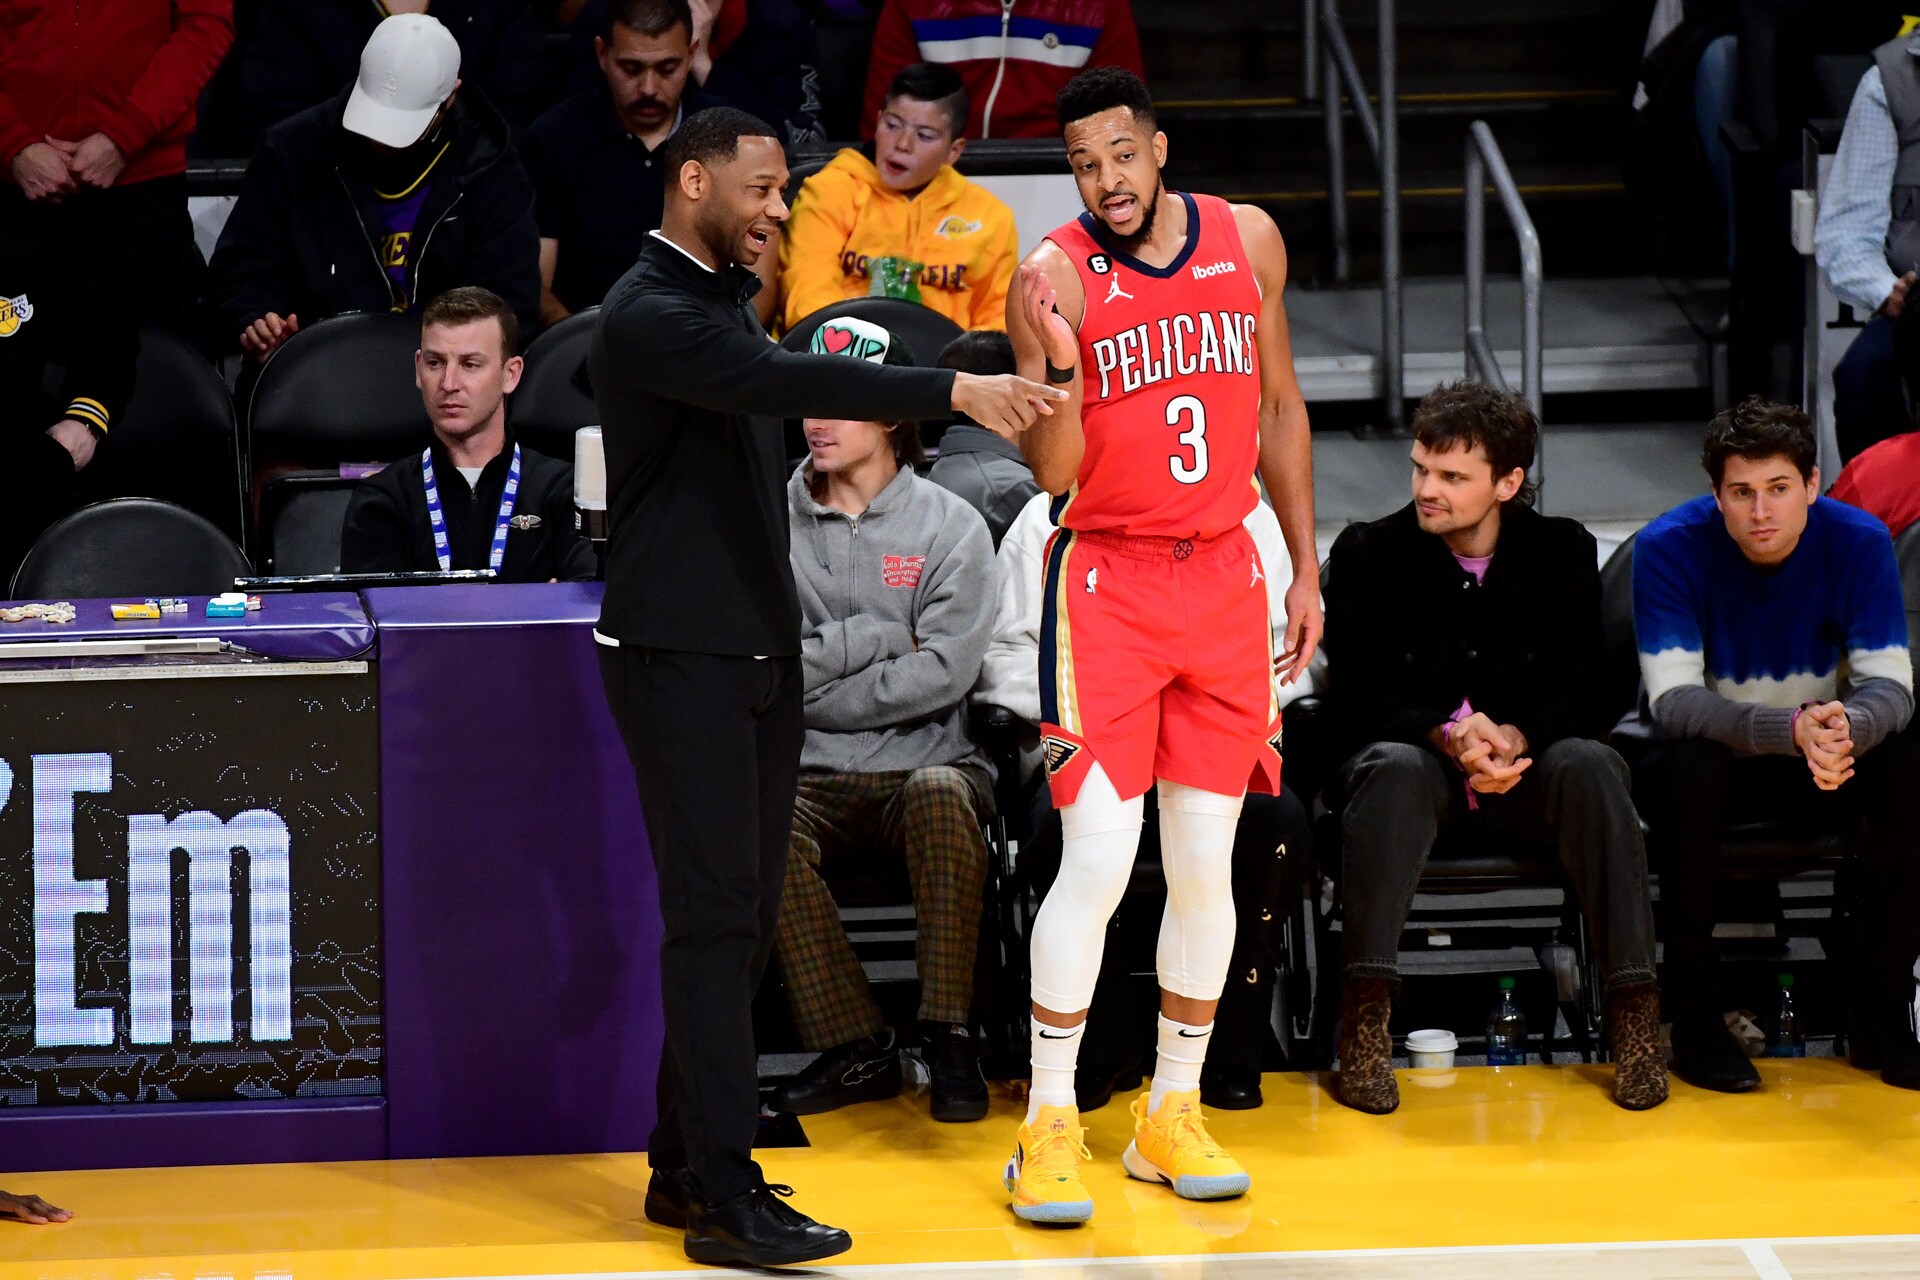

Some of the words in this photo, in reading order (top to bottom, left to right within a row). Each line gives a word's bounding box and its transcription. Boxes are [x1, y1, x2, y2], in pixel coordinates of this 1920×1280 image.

[1091, 256, 1109, 273] 6
[1192, 261, 1236, 280] ibotta
[1093, 311, 1256, 399] PELICANS
[1165, 394, 1210, 486] 3
